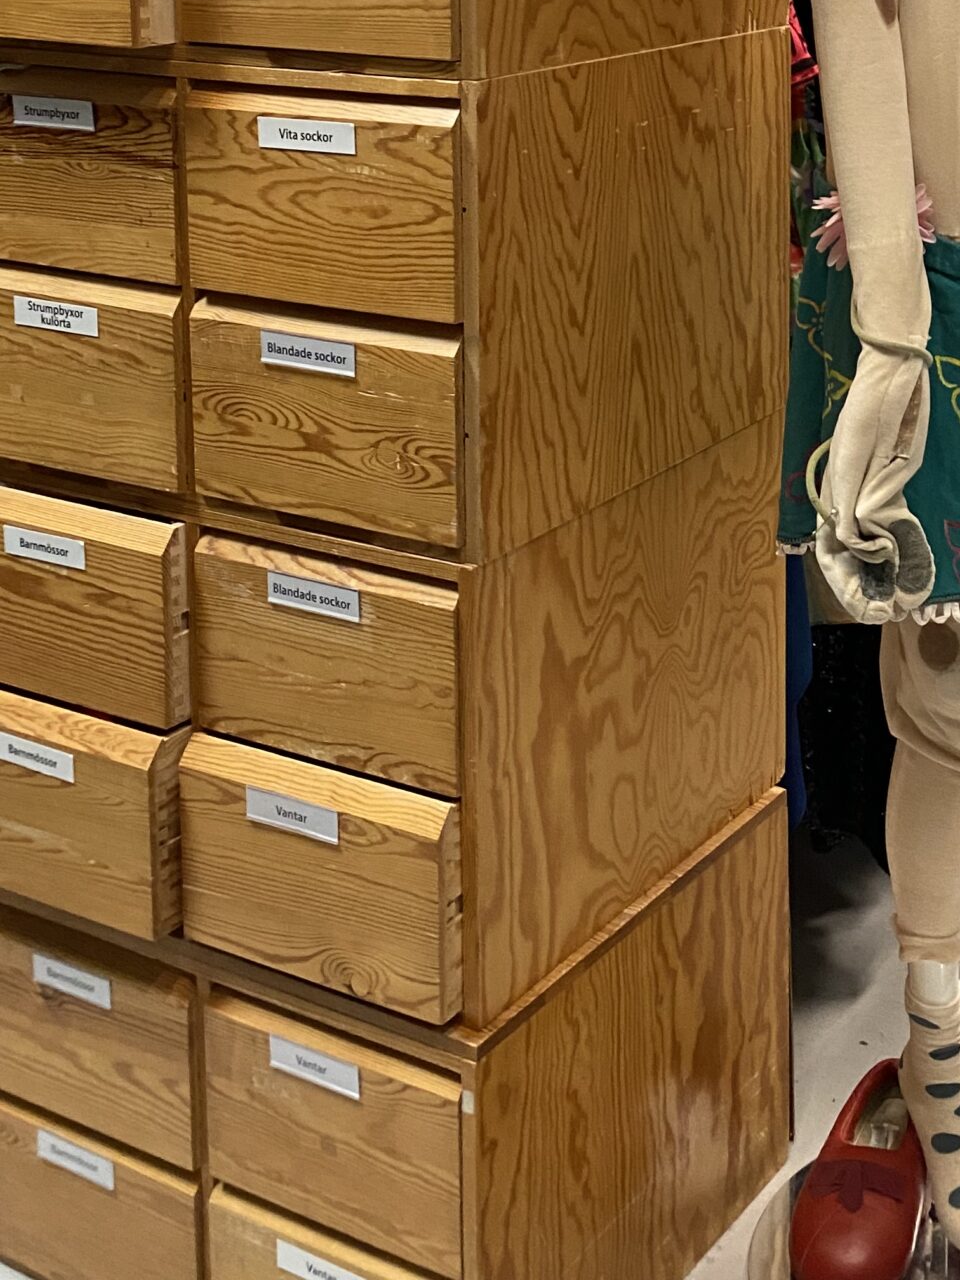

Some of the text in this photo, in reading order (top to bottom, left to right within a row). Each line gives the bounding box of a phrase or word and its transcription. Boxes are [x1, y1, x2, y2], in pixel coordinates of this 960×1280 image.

[24, 104, 80, 121] Strumpbyxor
[279, 127, 333, 143] Vita sockor
[27, 300, 84, 319] Strumpbyxor
[40, 313, 71, 329] kulörta
[267, 342, 347, 365] Blandade sockor
[19, 537, 69, 558] Barnmössor
[272, 582, 352, 611] Blandade sockor
[275, 804, 309, 824] Vantar
[295, 1053, 328, 1075] Vantar
